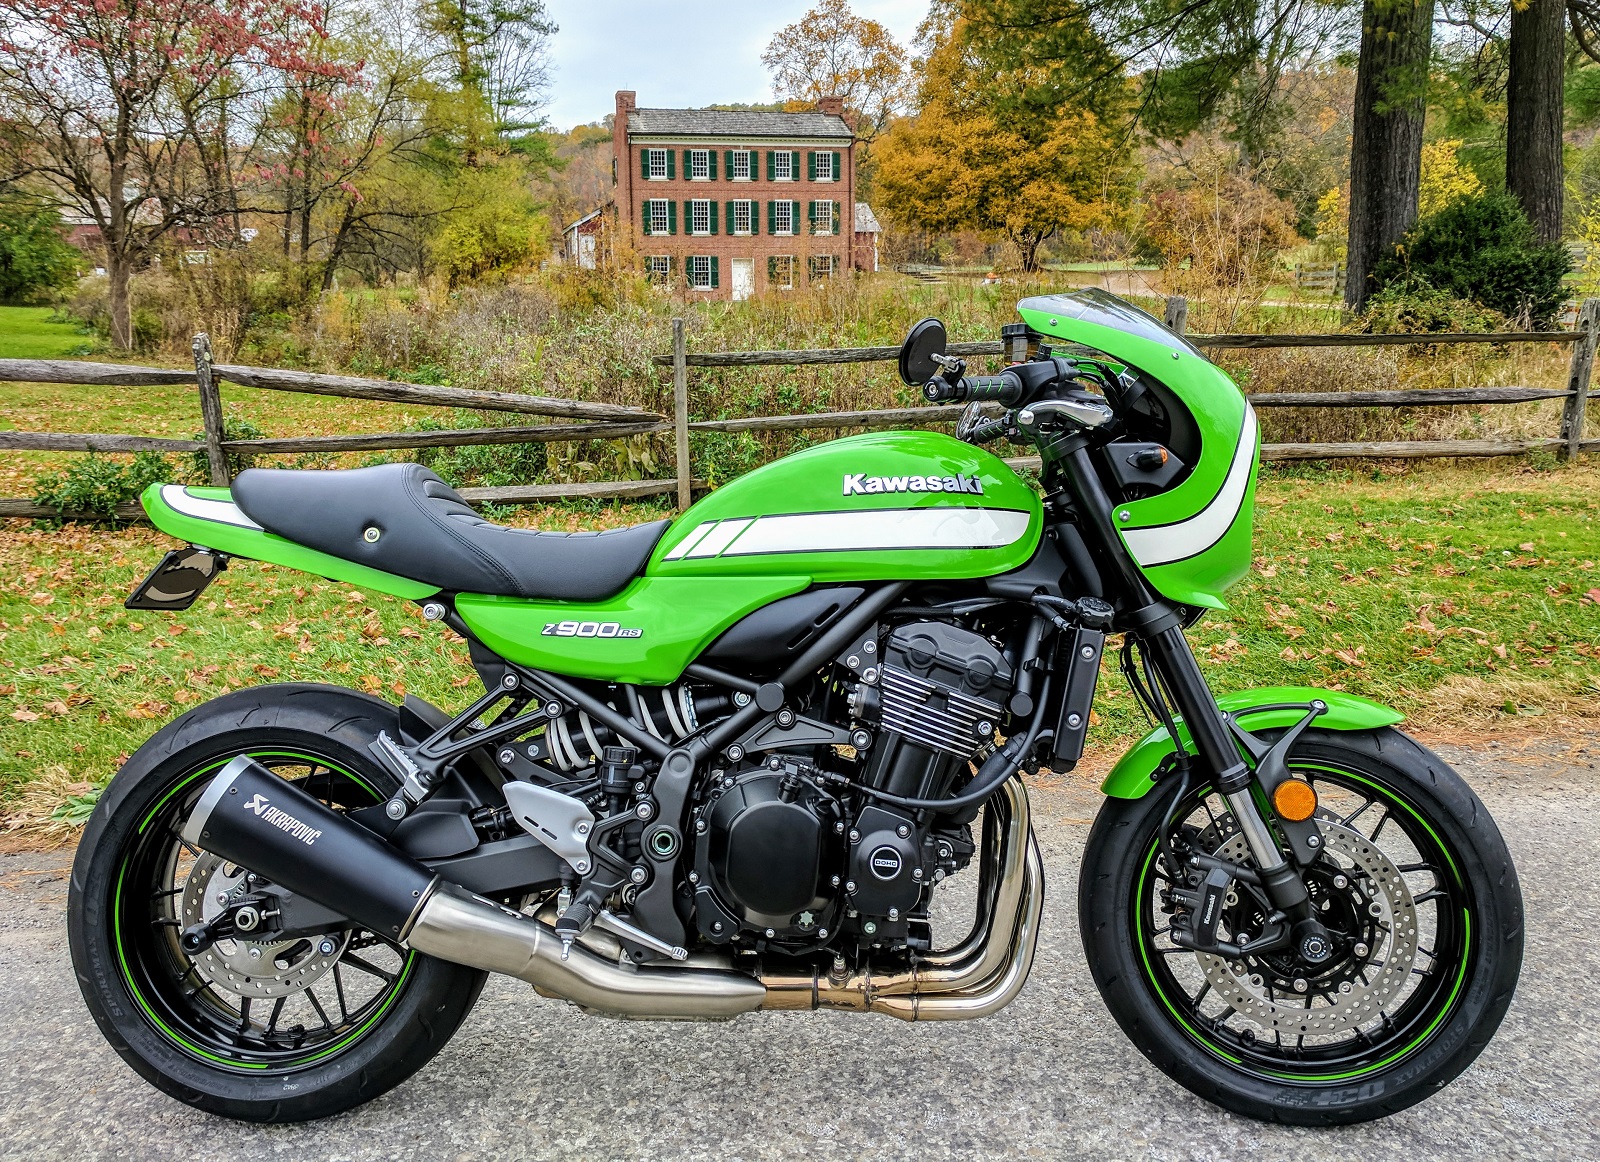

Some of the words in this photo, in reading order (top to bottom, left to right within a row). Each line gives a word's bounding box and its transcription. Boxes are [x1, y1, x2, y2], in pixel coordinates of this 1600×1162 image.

[843, 473, 984, 496] Kawasaki
[875, 859, 898, 868] DOHC
[1203, 894, 1216, 925] Kawasaki
[1393, 1024, 1465, 1088] SPORTMAX
